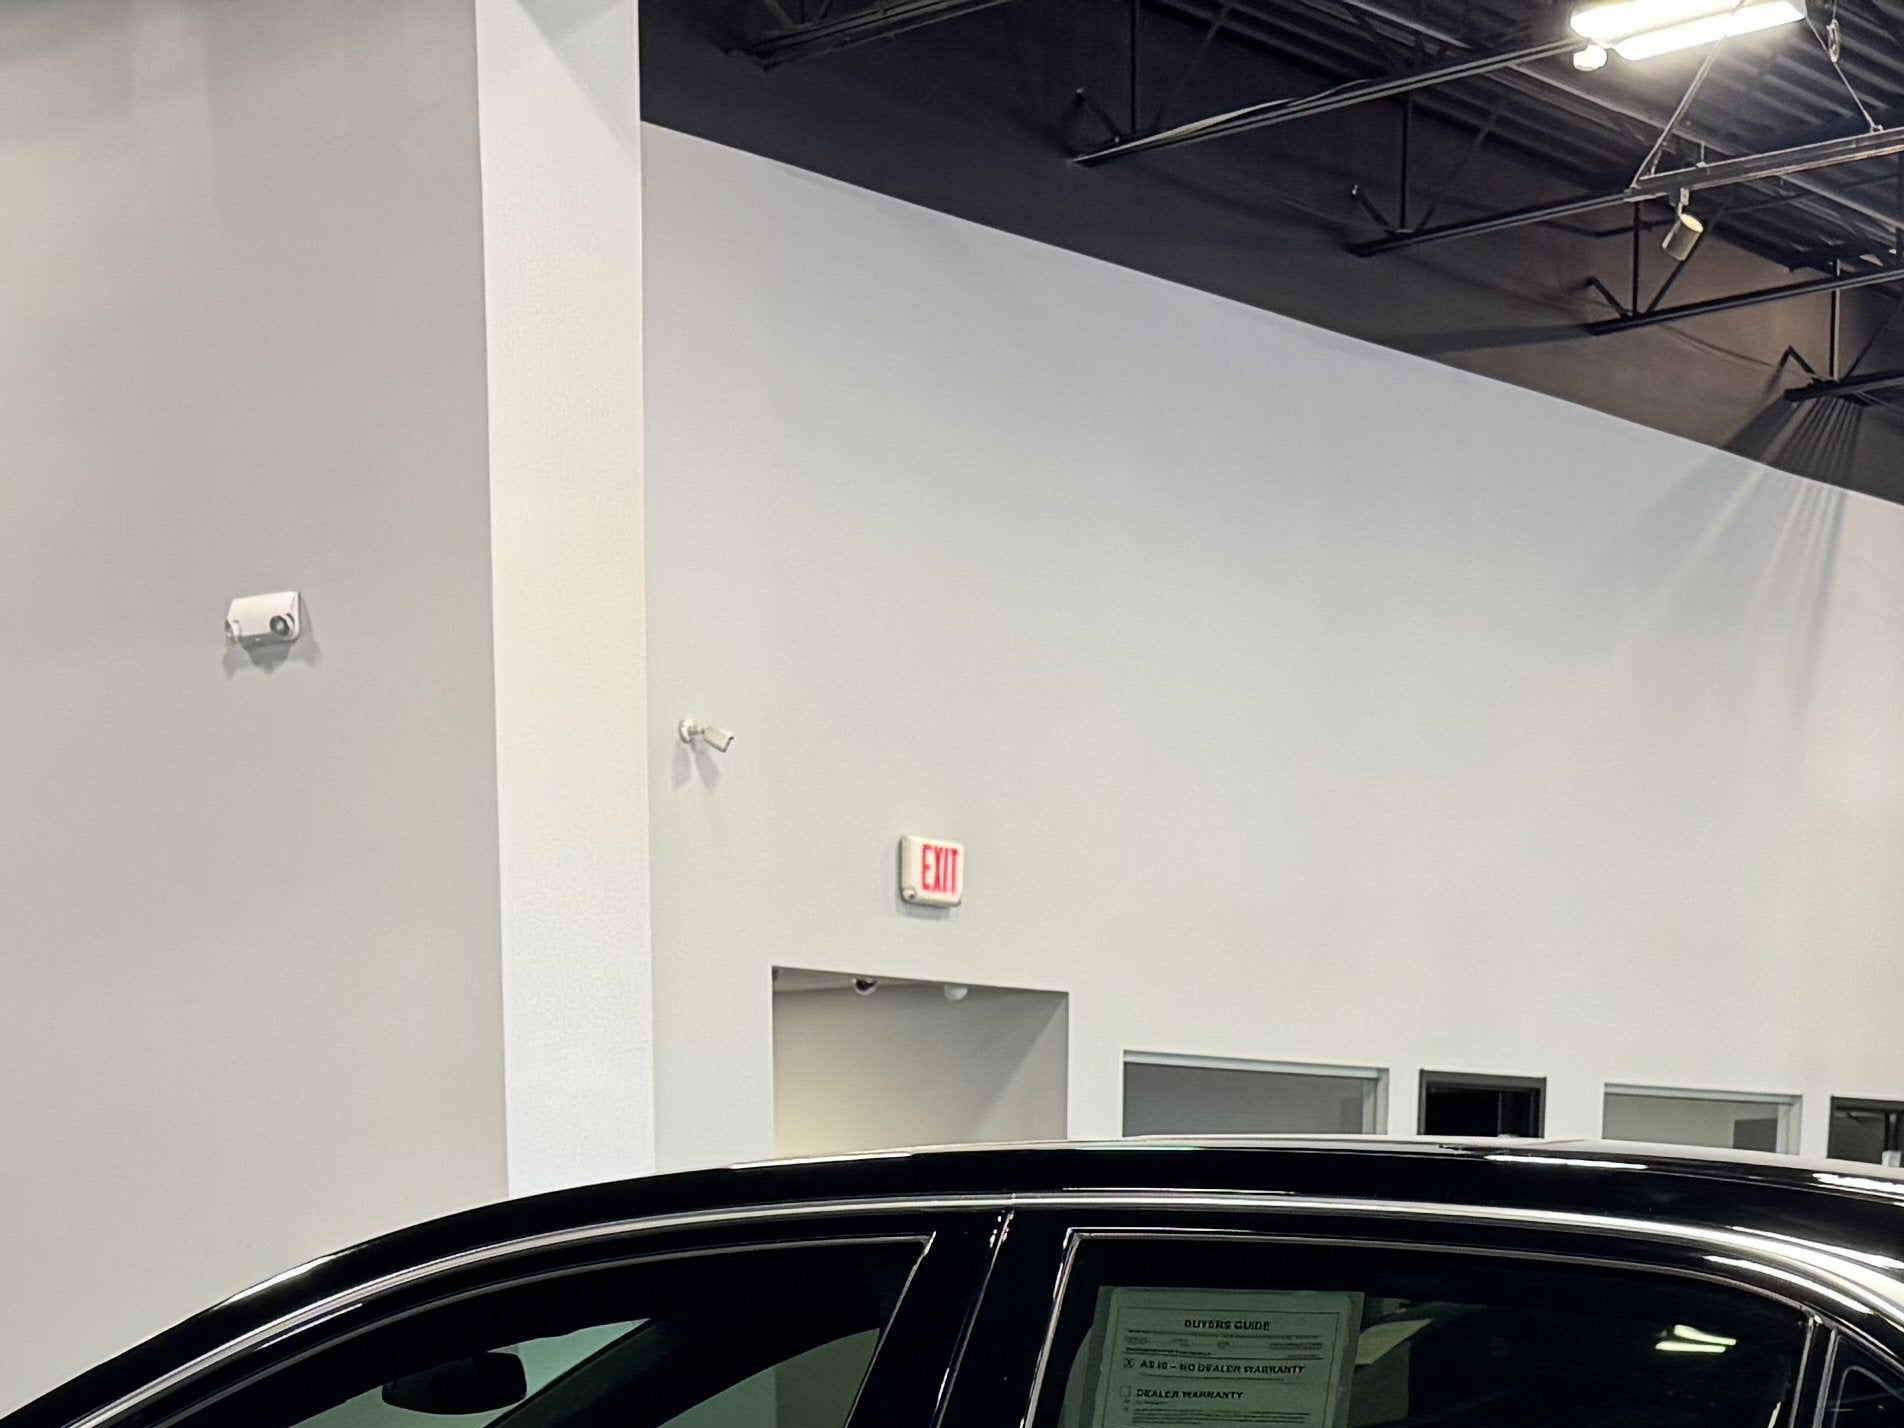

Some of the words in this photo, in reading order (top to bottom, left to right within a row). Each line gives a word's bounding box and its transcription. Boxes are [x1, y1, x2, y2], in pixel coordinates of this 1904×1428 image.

[921, 844, 958, 895] EXIT
[1184, 1319, 1231, 1330] BUYERS
[1234, 1320, 1271, 1331] GUIDE
[1198, 1363, 1241, 1373] DEALER
[1243, 1364, 1305, 1375] WARRANTY
[1136, 1388, 1179, 1398] DEALER
[1182, 1391, 1243, 1400] WARRANTY
